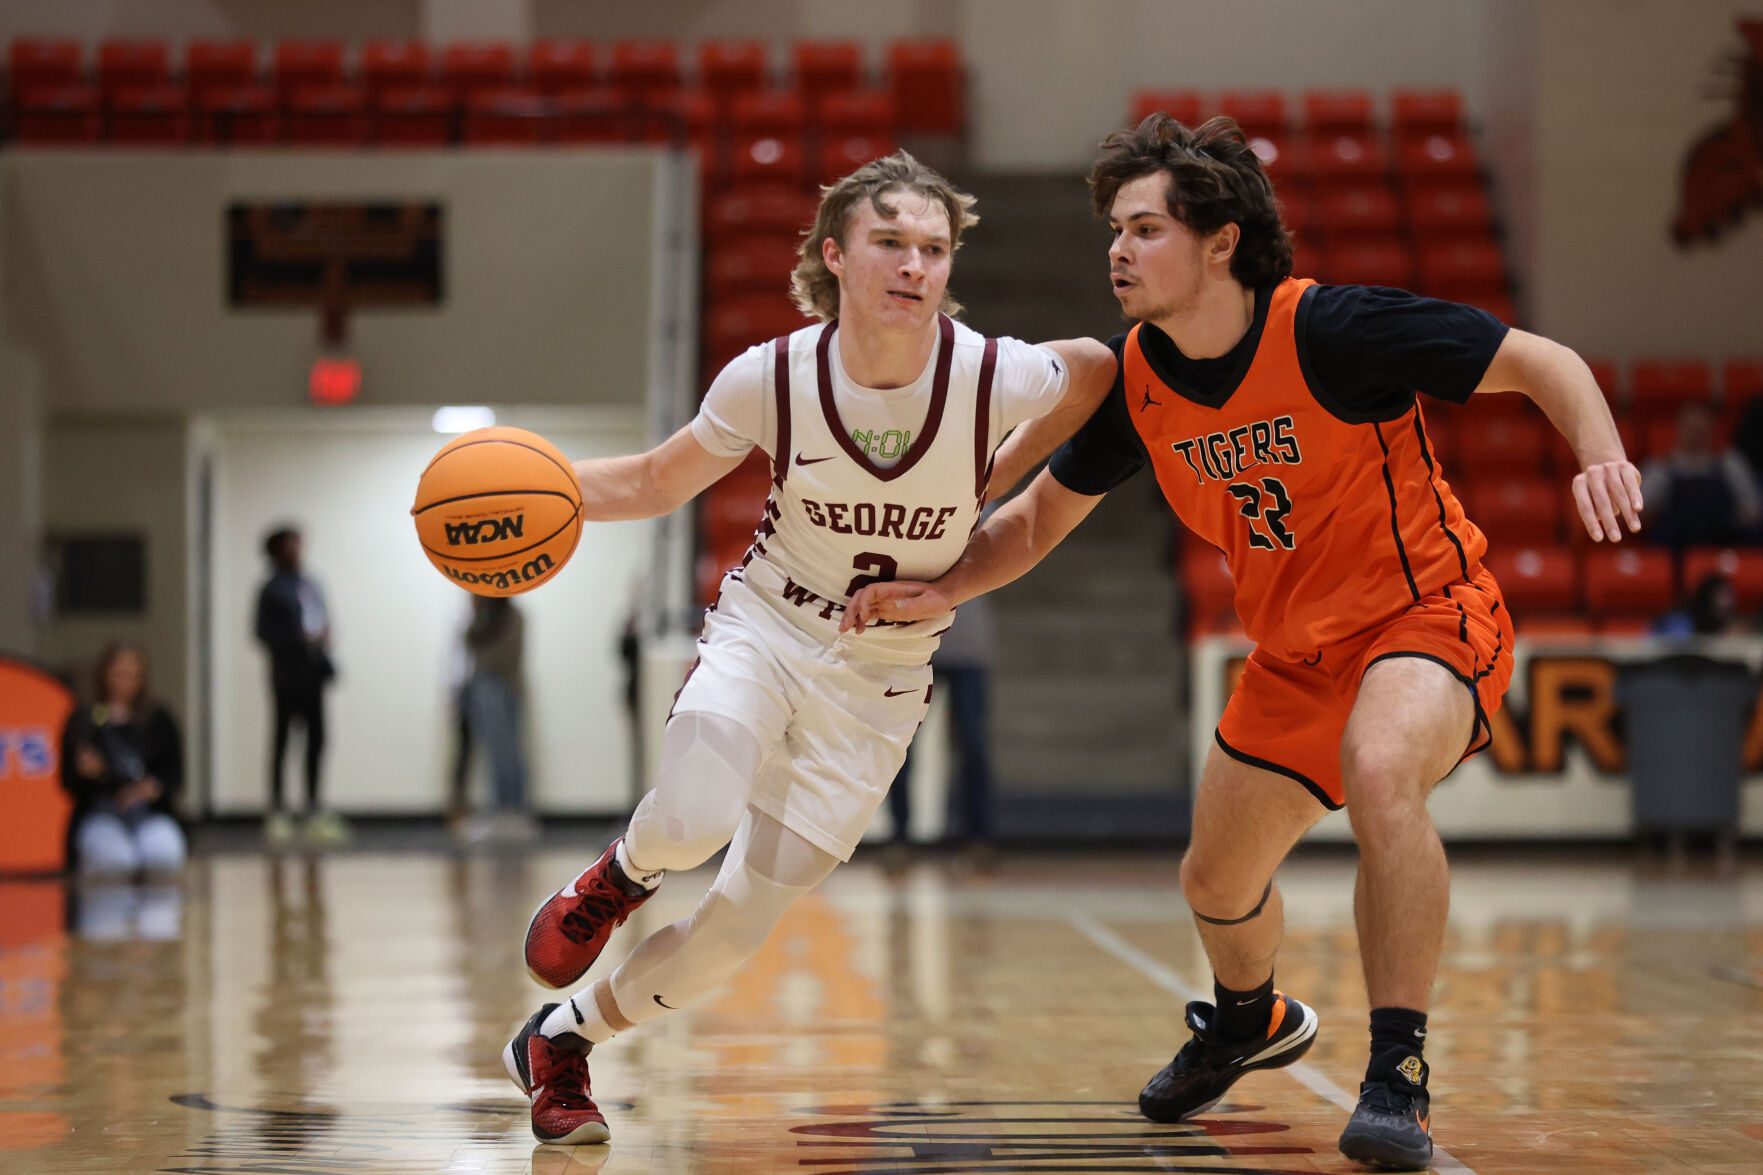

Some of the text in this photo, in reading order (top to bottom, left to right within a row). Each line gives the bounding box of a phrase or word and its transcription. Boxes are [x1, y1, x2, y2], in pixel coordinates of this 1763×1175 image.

[1171, 415, 1302, 485] TIGERS
[444, 514, 524, 546] NCAA
[801, 498, 957, 541] GEORGE
[1224, 476, 1296, 551] 22
[442, 552, 556, 589] Wilson
[845, 551, 898, 597] 2
